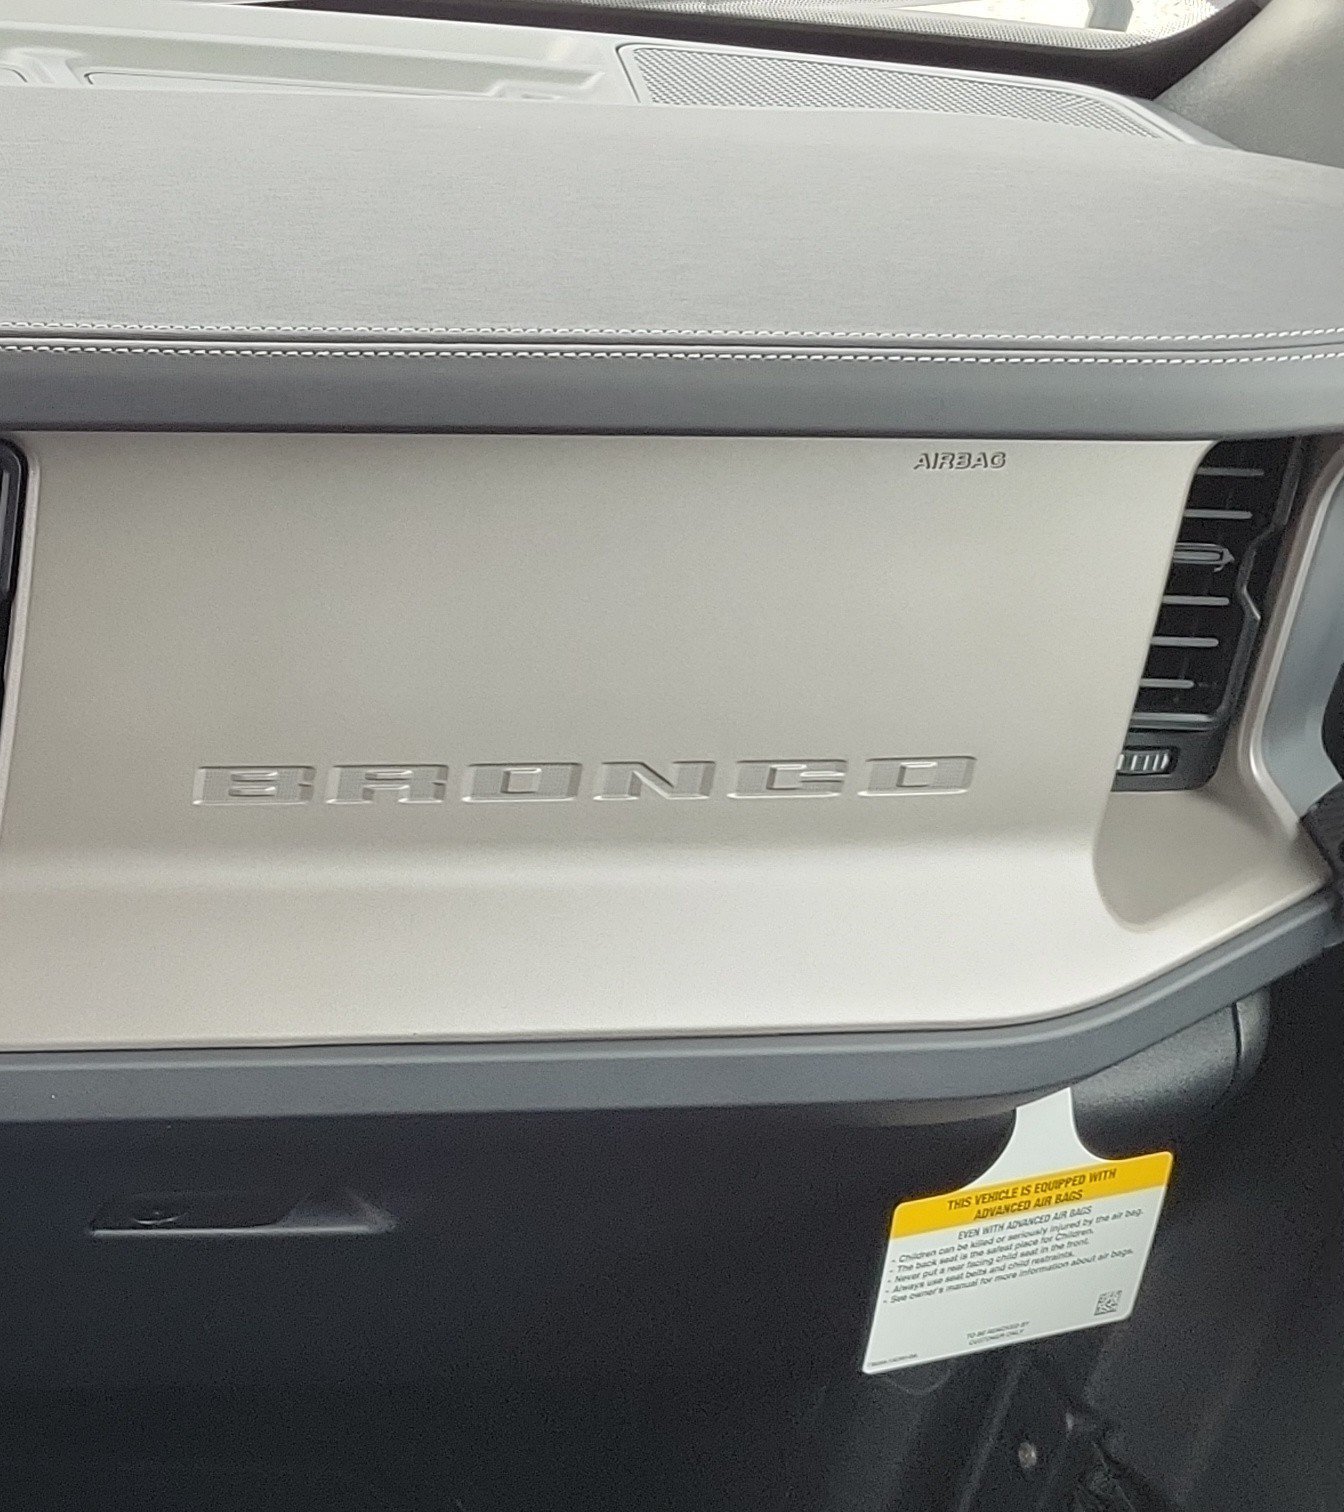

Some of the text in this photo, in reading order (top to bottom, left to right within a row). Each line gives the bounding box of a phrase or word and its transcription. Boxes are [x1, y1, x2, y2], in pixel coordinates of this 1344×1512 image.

[913, 451, 1007, 470] AIRBAG
[192, 755, 978, 806] BRONCO
[947, 1168, 1117, 1210] THIS VEHICLE IS EQUIPPED WITH
[973, 1189, 1083, 1219] ADVANCED AIR BAGS
[957, 1204, 1092, 1240] EVEN WITH ADVANCED AIR BAGS
